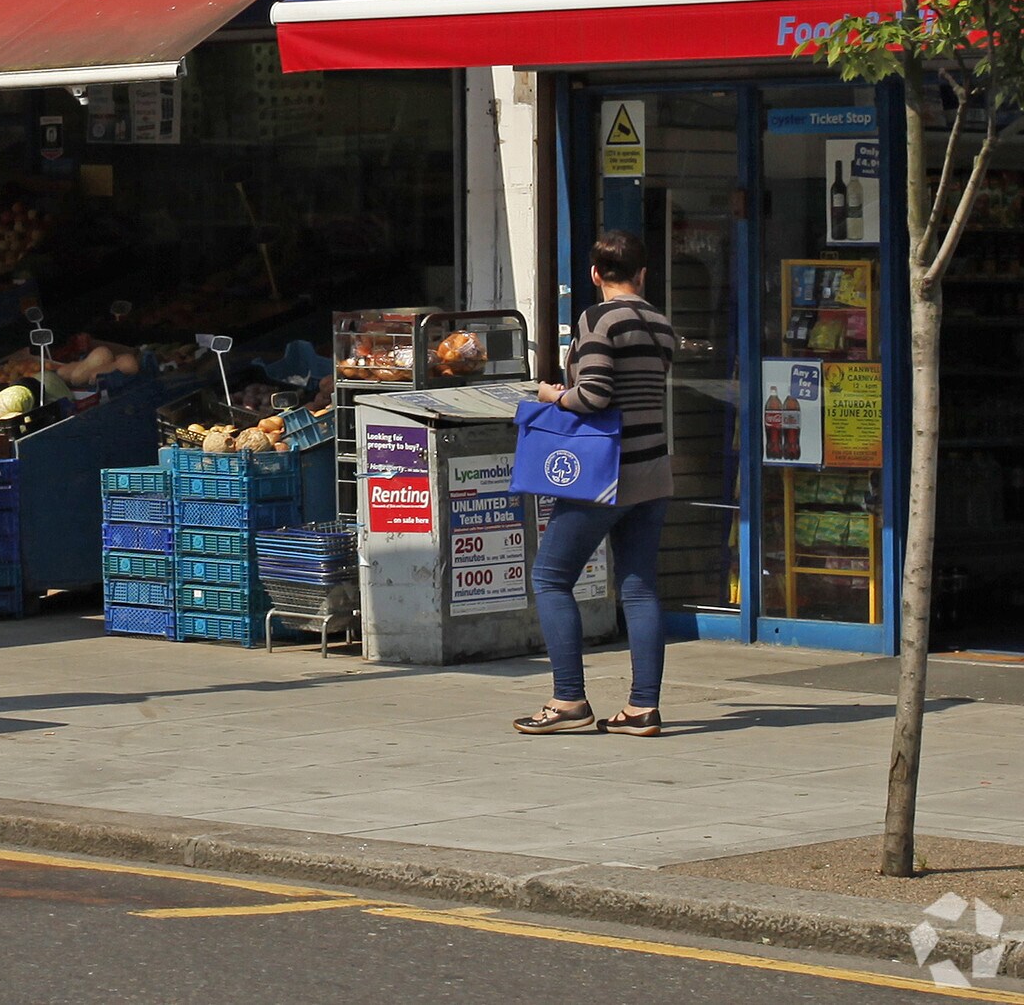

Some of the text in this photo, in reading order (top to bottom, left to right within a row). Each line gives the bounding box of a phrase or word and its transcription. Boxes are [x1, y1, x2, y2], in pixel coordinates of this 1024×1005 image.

[809, 112, 844, 125] Ticket
[846, 112, 872, 125] Stop
[859, 146, 879, 157] Only
[793, 367, 818, 379] Any 2
[798, 378, 812, 387] for
[798, 388, 811, 397] £2
[832, 399, 877, 408] SATURDAY
[827, 408, 837, 417] 15
[839, 408, 861, 417] JUNE
[367, 432, 403, 442] Looking for
[367, 442, 395, 450] property
[396, 442, 404, 450] to
[371, 485, 430, 508] Renting
[451, 497, 507, 513] UNLIMITED
[402, 516, 415, 524] sale
[415, 516, 429, 524] here
[459, 511, 515, 525] Texts & Data
[454, 532, 522, 554] 250 £10
[454, 554, 485, 563] minutes
[455, 566, 523, 587] 1000 £20
[454, 587, 486, 597] minutes
